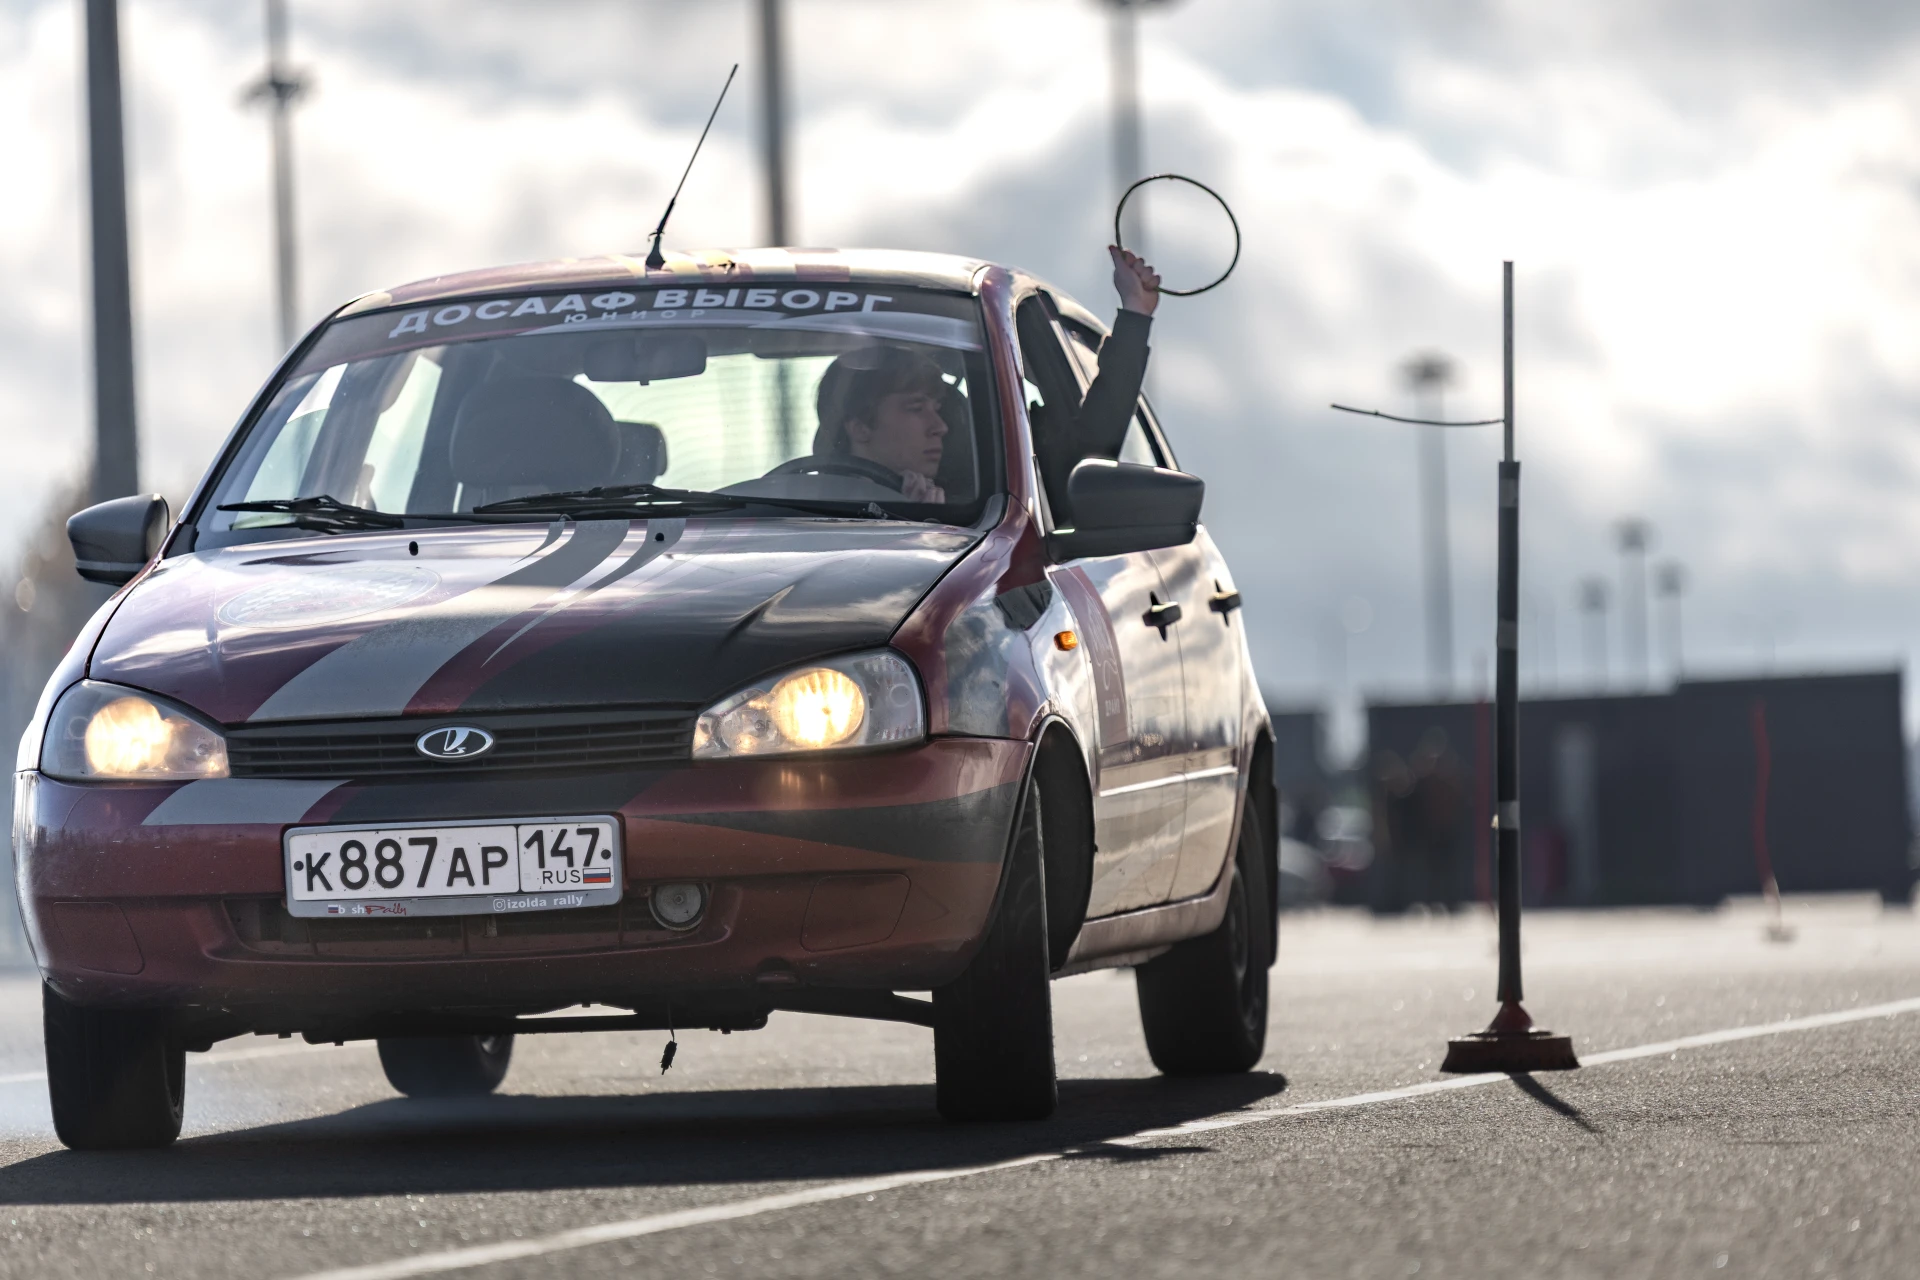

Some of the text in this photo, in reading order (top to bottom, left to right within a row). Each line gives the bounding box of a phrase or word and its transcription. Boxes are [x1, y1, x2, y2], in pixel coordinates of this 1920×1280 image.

[387, 288, 893, 339] ДОСААФ ВЫБОРГ
[564, 309, 706, 324] ЮНИОР
[523, 827, 601, 869] 147
[542, 869, 581, 885] RUS
[506, 894, 584, 909] izolda rally
